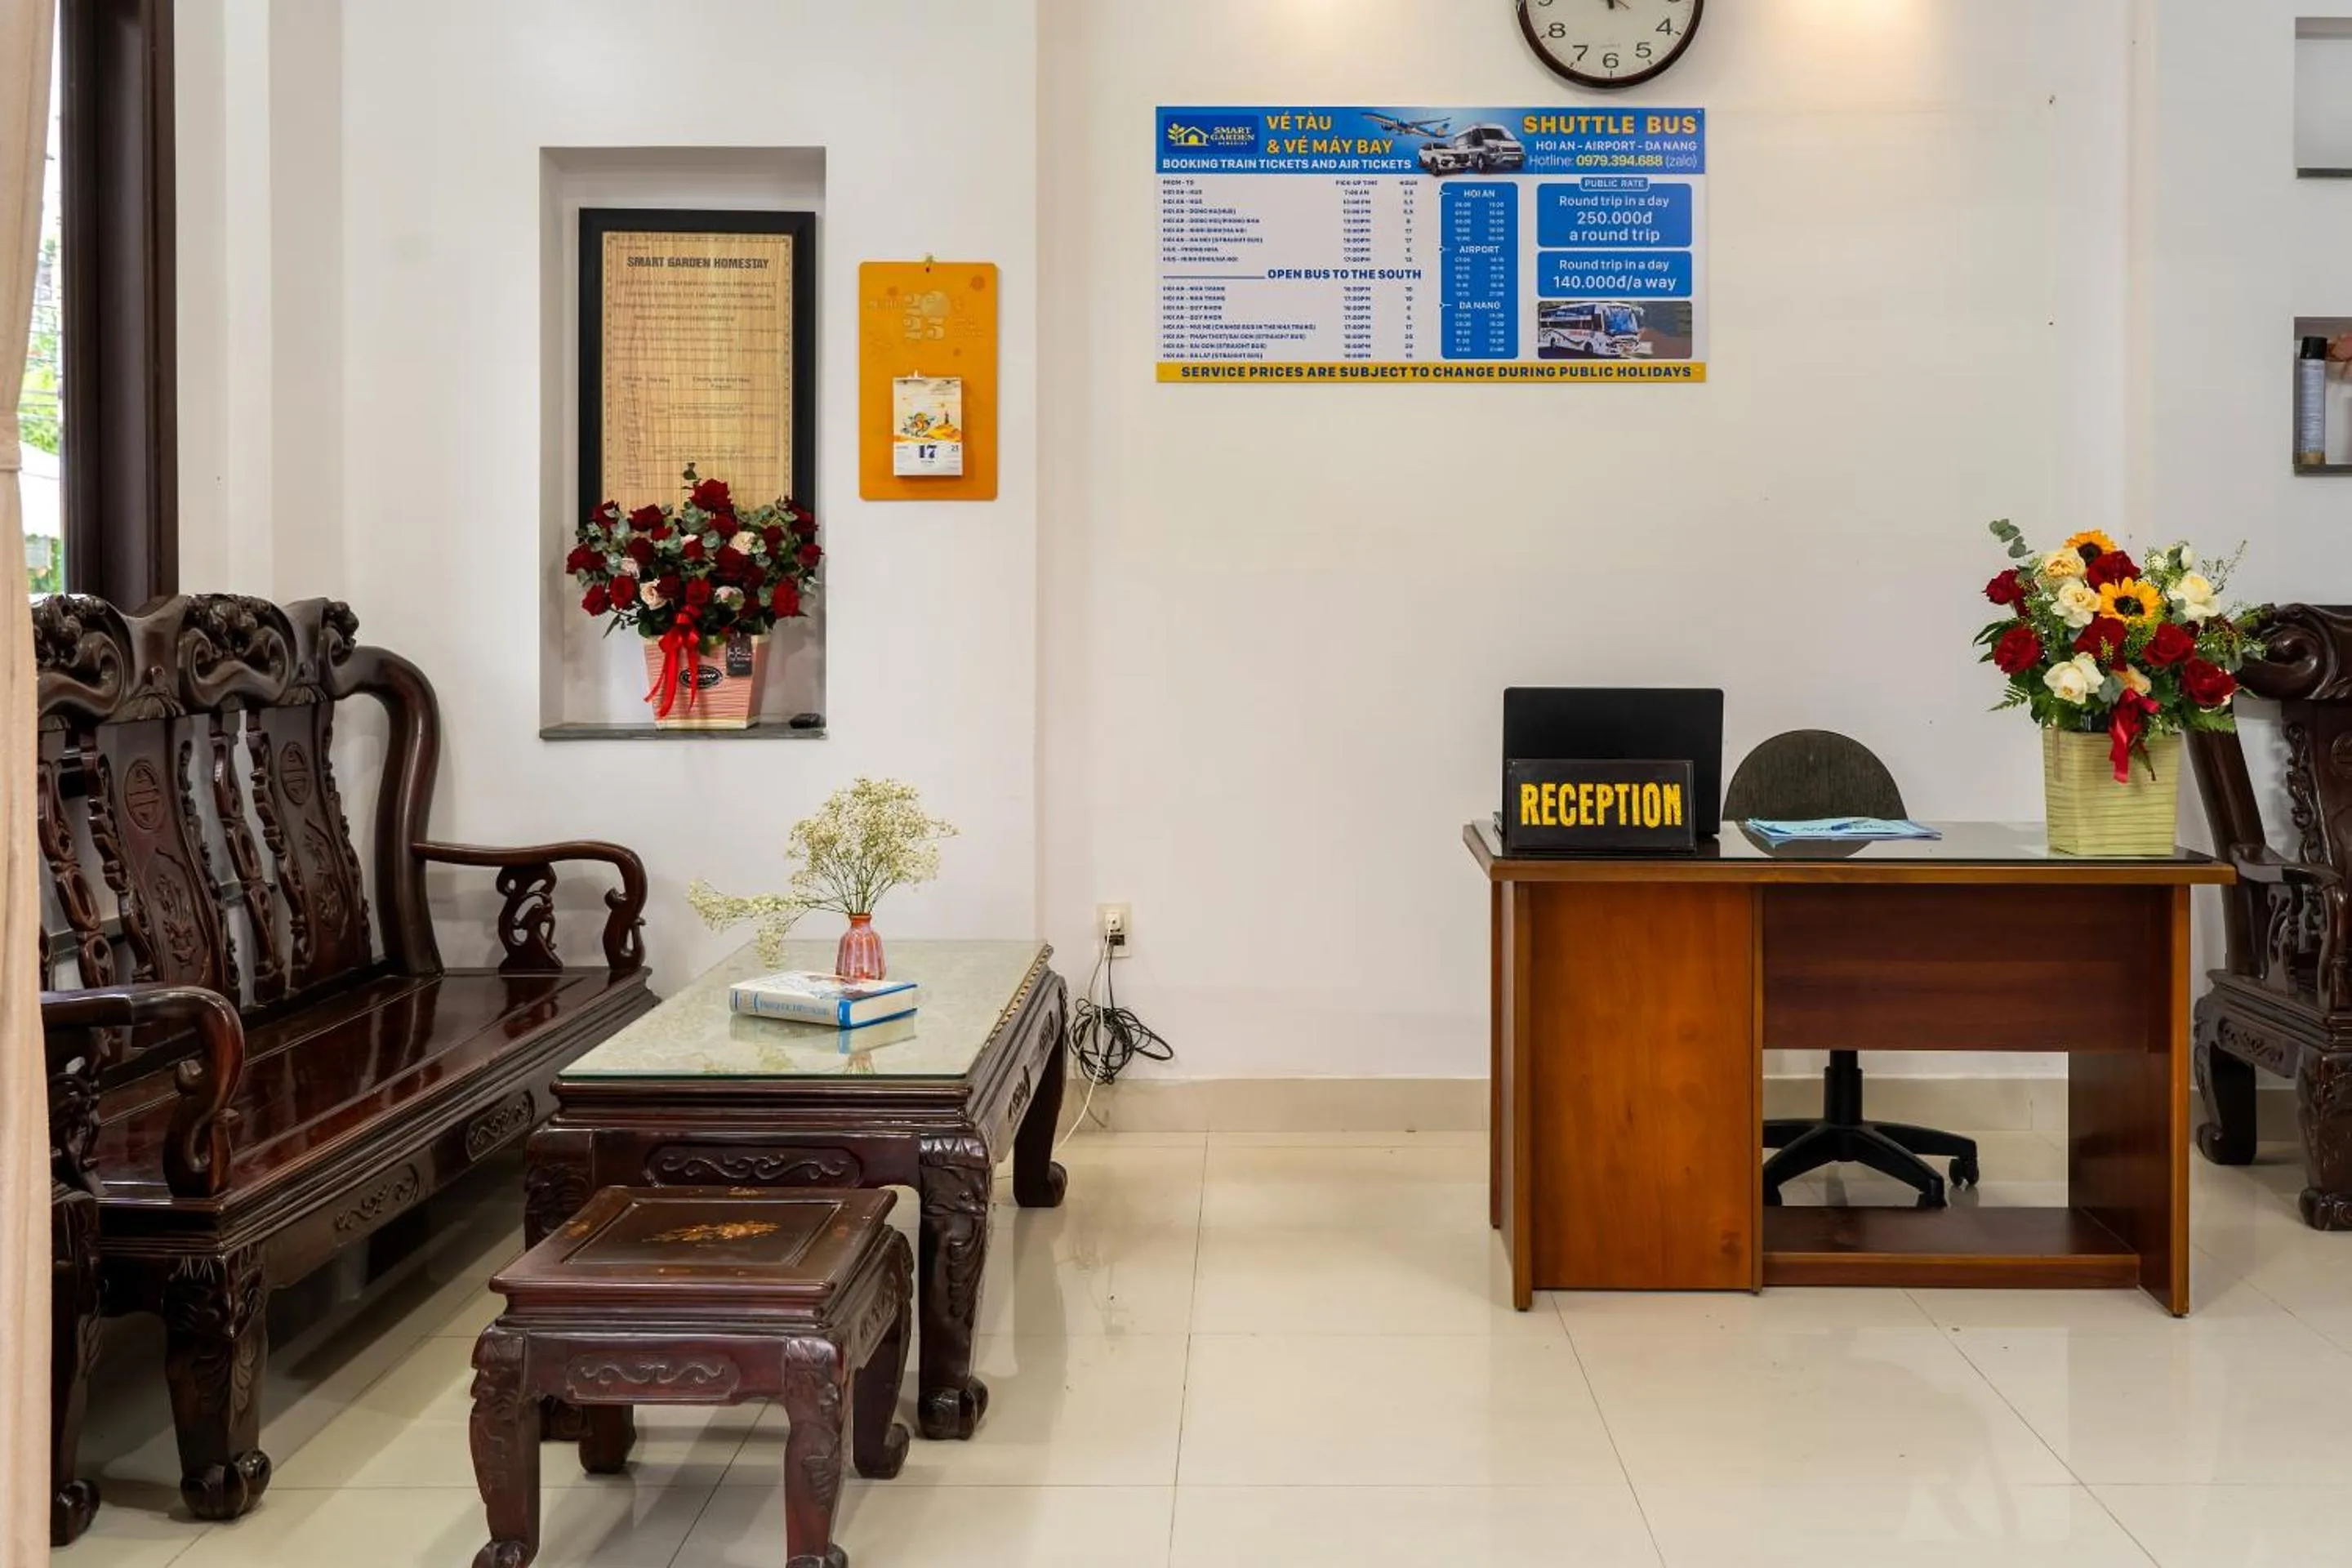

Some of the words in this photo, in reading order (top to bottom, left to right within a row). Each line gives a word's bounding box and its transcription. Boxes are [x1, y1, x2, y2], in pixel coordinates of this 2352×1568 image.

[1548, 23, 1566, 38] 8
[1655, 18, 1673, 35] 4
[1573, 45, 1588, 62] 7
[1636, 42, 1652, 59] 5
[1602, 53, 1619, 69] 6
[1267, 110, 1290, 130] VÉ
[1295, 110, 1332, 130] TÀU
[1523, 115, 1635, 134] SHUTTLE
[1646, 115, 1697, 134] BUS
[1267, 139, 1281, 154] &
[1284, 136, 1307, 154] VÉ
[1312, 136, 1352, 154] MÁY
[1357, 139, 1393, 154] BAY
[1535, 140, 1557, 151] HOI
[1559, 140, 1575, 151] AN
[1584, 140, 1635, 151] AIRPORT
[1645, 140, 1661, 151] DA
[1663, 140, 1698, 151] NANG
[1163, 158, 1218, 168] BOOKING
[1221, 158, 1257, 168] TRAIN
[1258, 158, 1308, 168] TICKETS
[1312, 159, 1336, 168] AND
[1339, 159, 1360, 168] AIR
[1361, 159, 1411, 168] TICKETS
[1529, 154, 1574, 166] Hotline:
[1665, 154, 1698, 168] (zalo)
[1584, 179, 1618, 188] PUBLIC
[1620, 179, 1645, 188] RATE
[1482, 189, 1495, 198] AN
[1559, 195, 1598, 206] Round
[1601, 195, 1623, 208] trip
[1625, 195, 1637, 206] in
[1638, 198, 1646, 206] a
[1647, 195, 1669, 208] day
[1570, 230, 1579, 241] a
[1582, 228, 1628, 241] round
[1632, 228, 1660, 243] trip
[627, 256, 666, 268] SMART
[668, 256, 711, 269] GARDEN
[714, 257, 769, 270] HOMESTAY
[1559, 260, 1599, 270] Round
[1601, 260, 1623, 272] trip
[1625, 260, 1637, 270] in
[1638, 261, 1646, 270] a
[1647, 260, 1669, 272] day
[1267, 270, 1302, 279] OPEN
[1304, 270, 1330, 279] BUS
[1332, 270, 1348, 279] TO
[1351, 270, 1375, 279] THE
[1377, 270, 1423, 279] SOUTH
[1645, 278, 1677, 292] way
[1182, 366, 1245, 377] SERVICE
[1249, 366, 1303, 377] PRICES
[1307, 366, 1336, 377] ARE
[1339, 366, 1407, 377] SUBJECT
[1410, 366, 1429, 377] TO
[1432, 366, 1494, 377] CHANGE
[1499, 366, 1556, 377] DURING
[1560, 366, 1614, 377] PUBLIC
[1617, 366, 1691, 377] HOLIDAYS
[919, 444, 938, 459] 17
[1521, 782, 1682, 827] RECEPTION
